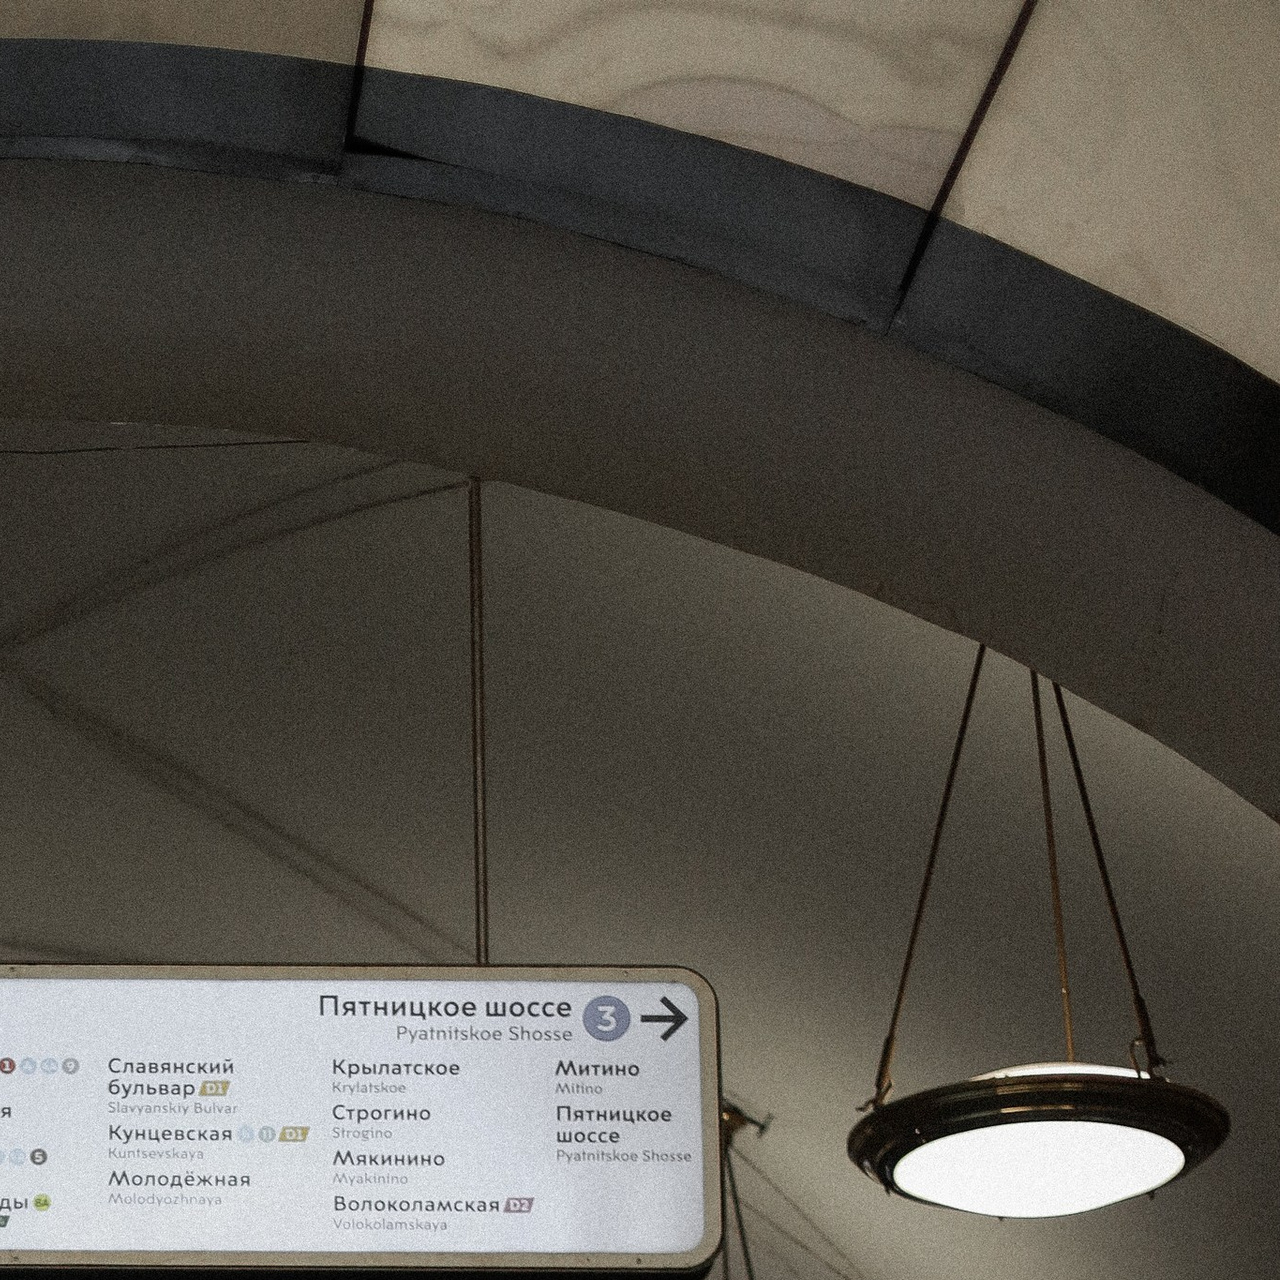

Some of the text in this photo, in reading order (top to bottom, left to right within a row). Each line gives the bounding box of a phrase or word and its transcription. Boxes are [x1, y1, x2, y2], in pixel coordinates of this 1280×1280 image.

[320, 996, 616, 1032] Пятницкое шоссе 3
[396, 1026, 573, 1043] Pyatnitskoe Shosse
[108, 1059, 234, 1075] Славянский
[333, 1060, 460, 1079] Крылатское
[556, 1061, 640, 1076] Митино
[108, 1078, 195, 1099] бульвар
[333, 1081, 406, 1096] Krylatskoe
[556, 1083, 602, 1094] Mitino
[108, 1102, 238, 1116] Slavyanskiy Bulvar
[333, 1105, 431, 1123] Строгино
[557, 1106, 672, 1124] Пятницкое
[109, 1126, 232, 1145] Кунцевская
[333, 1127, 393, 1141] Strogino
[557, 1129, 620, 1142] шоссе
[108, 1148, 204, 1162] Kuntsevskaya
[333, 1151, 445, 1167] Мякинино
[557, 1149, 692, 1163] Pyatnitskoe Shosse
[109, 1171, 251, 1188] Молодёжная
[333, 1173, 408, 1187] Myakinino
[108, 1193, 222, 1207] Molodyozhnaya
[334, 1197, 529, 1213] Волоколамская D2
[334, 1218, 447, 1232] Volokolamskaya
